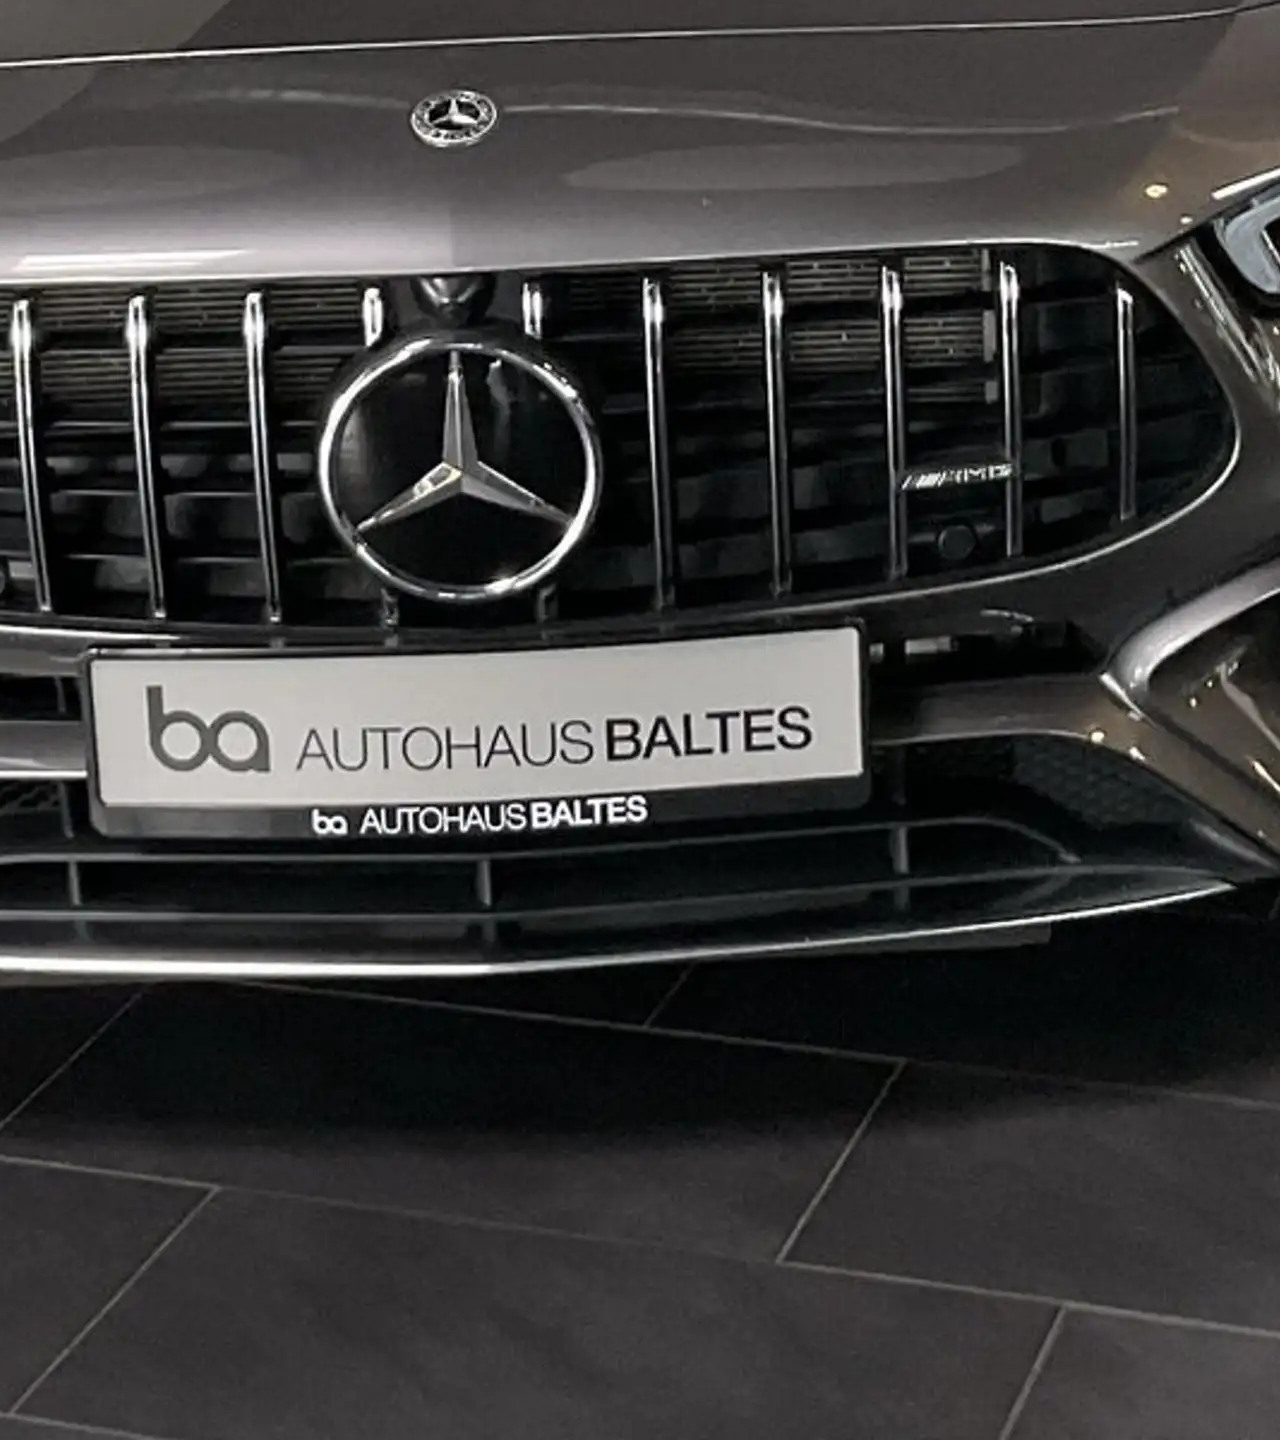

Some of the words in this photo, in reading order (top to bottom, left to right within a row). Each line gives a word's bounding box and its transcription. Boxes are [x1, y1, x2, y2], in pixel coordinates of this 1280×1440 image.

[146, 685, 271, 773] ba
[296, 719, 595, 772] AUTOHAUS
[605, 705, 812, 762] BALTES
[359, 804, 527, 835] AUTOHAUS
[530, 794, 648, 830] BALTES
